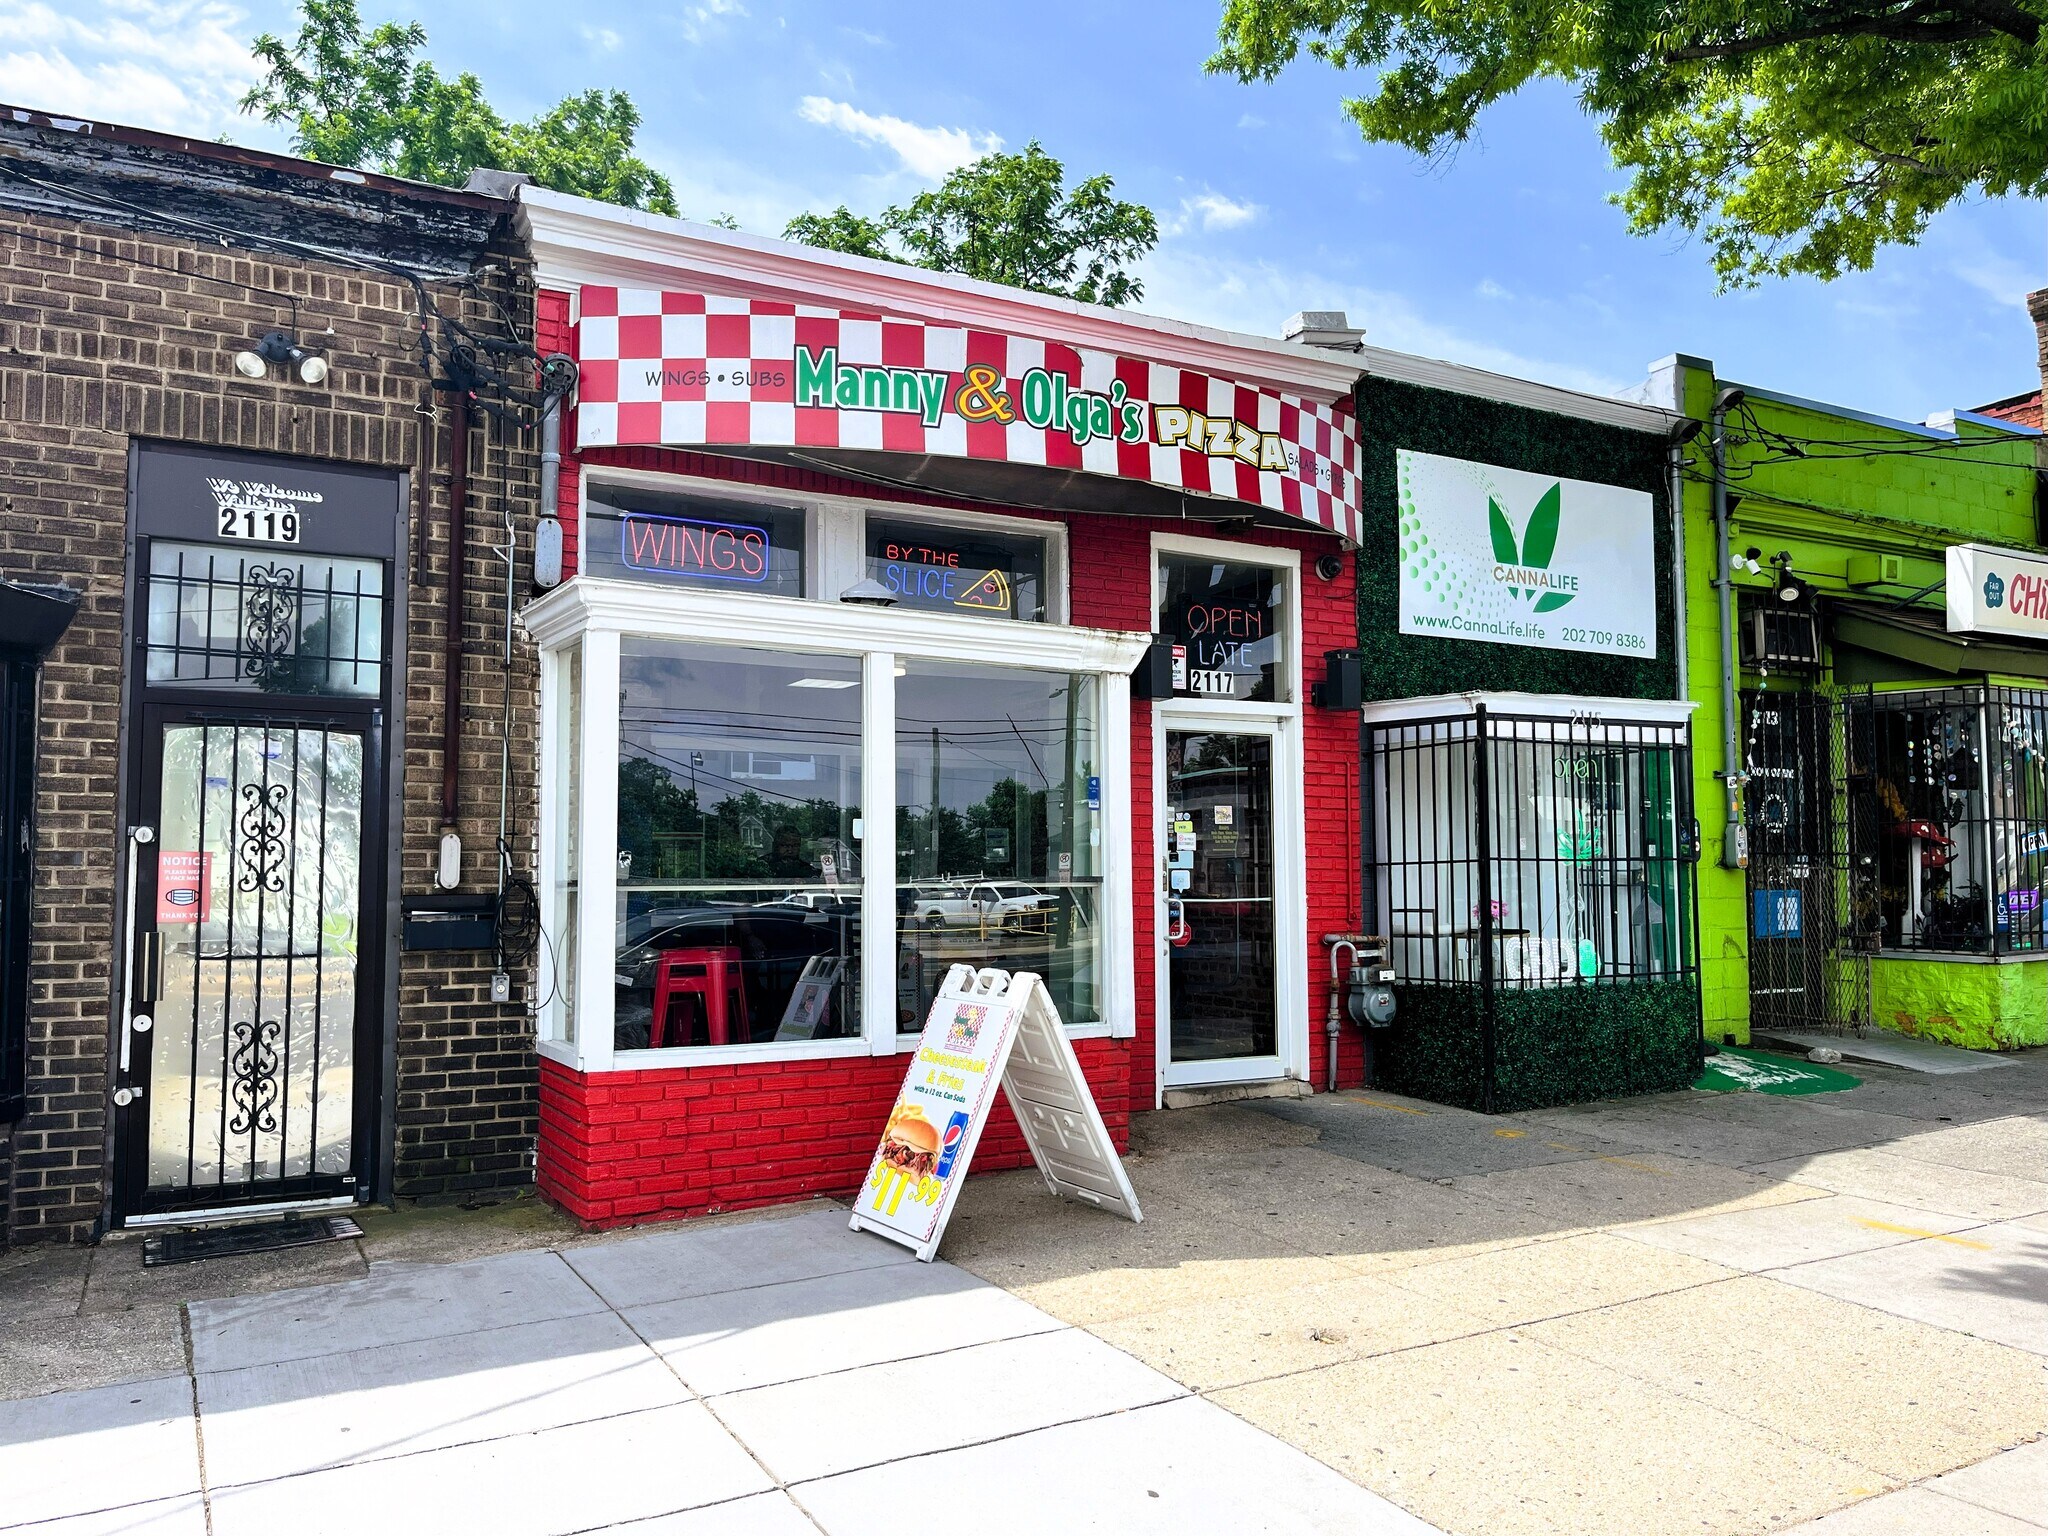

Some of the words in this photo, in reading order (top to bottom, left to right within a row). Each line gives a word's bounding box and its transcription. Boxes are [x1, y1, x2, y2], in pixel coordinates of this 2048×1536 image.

[645, 370, 711, 387] WINGS
[731, 371, 786, 388] SUBS
[793, 344, 951, 429] Manny
[954, 362, 1016, 425] &
[1021, 367, 1144, 446] Olga's
[1153, 403, 1290, 473] PIZZA
[1287, 452, 1319, 476] SALADS
[206, 477, 240, 495] We
[240, 480, 324, 503] Welcome
[221, 507, 298, 542] 2119
[628, 518, 764, 575] WINGS
[886, 543, 914, 561] BY
[918, 547, 960, 569] THE
[884, 564, 957, 601] SLICE
[1493, 566, 1579, 592] CANNALIFE
[1989, 581, 2000, 591] FAR
[1988, 591, 2000, 601] OUT
[1187, 604, 1262, 638] OPEN
[1412, 614, 1546, 640] www.CannaLife.life
[1562, 627, 1586, 642] 202
[1589, 630, 1613, 646] 709
[1616, 633, 1646, 649] 8386
[1198, 640, 1254, 668] LATE
[1192, 670, 1234, 692] 2117
[1570, 708, 1602, 729] 2115
[1554, 757, 1598, 784] open
[162, 856, 208, 866] NOTICE
[1506, 936, 1577, 982] CBD
[920, 1046, 987, 1074] Cheesesteak
[926, 1069, 936, 1085] &
[936, 1071, 966, 1091] Fries
[914, 1085, 925, 1093] with
[943, 1091, 953, 1100] Can
[953, 1094, 966, 1103] Soda
[870, 1159, 942, 1218] $11.99
